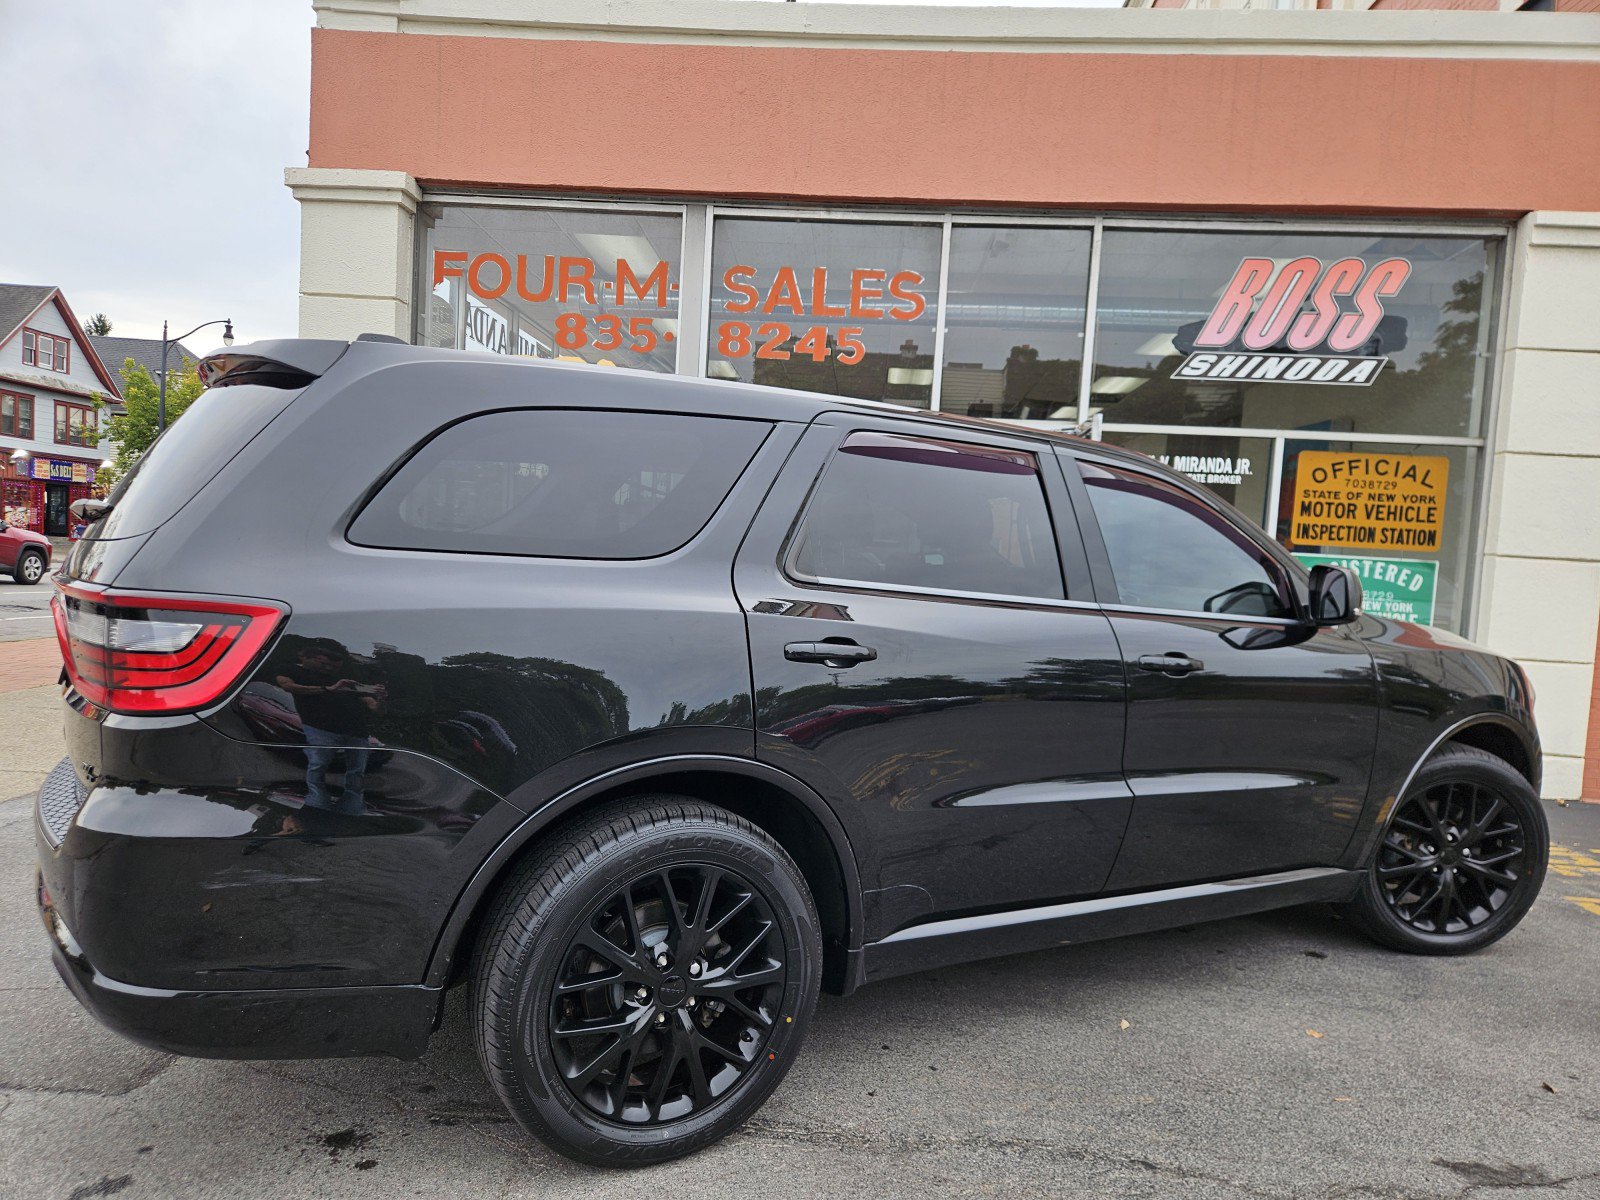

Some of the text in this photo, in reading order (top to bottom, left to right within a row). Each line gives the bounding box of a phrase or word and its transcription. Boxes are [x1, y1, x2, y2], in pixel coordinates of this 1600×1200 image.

[723, 265, 926, 322] SALES
[1193, 255, 1412, 353] BOSS
[717, 321, 866, 366] 8245
[1180, 354, 1378, 384] SHINODA
[1173, 455, 1233, 474] MIRANDA
[1234, 458, 1253, 475] JR.
[1312, 458, 1434, 489] OFFICIAL
[1207, 473, 1242, 485] BROKER
[1345, 478, 1398, 490] 7038729
[1303, 489, 1437, 505] STATE OF NEW YORK
[1300, 500, 1438, 524] MOTOR VEHICLE
[1296, 523, 1437, 547] INSPECTION STATION
[1330, 558, 1424, 592] STERED
[1385, 601, 1414, 613] YORK
